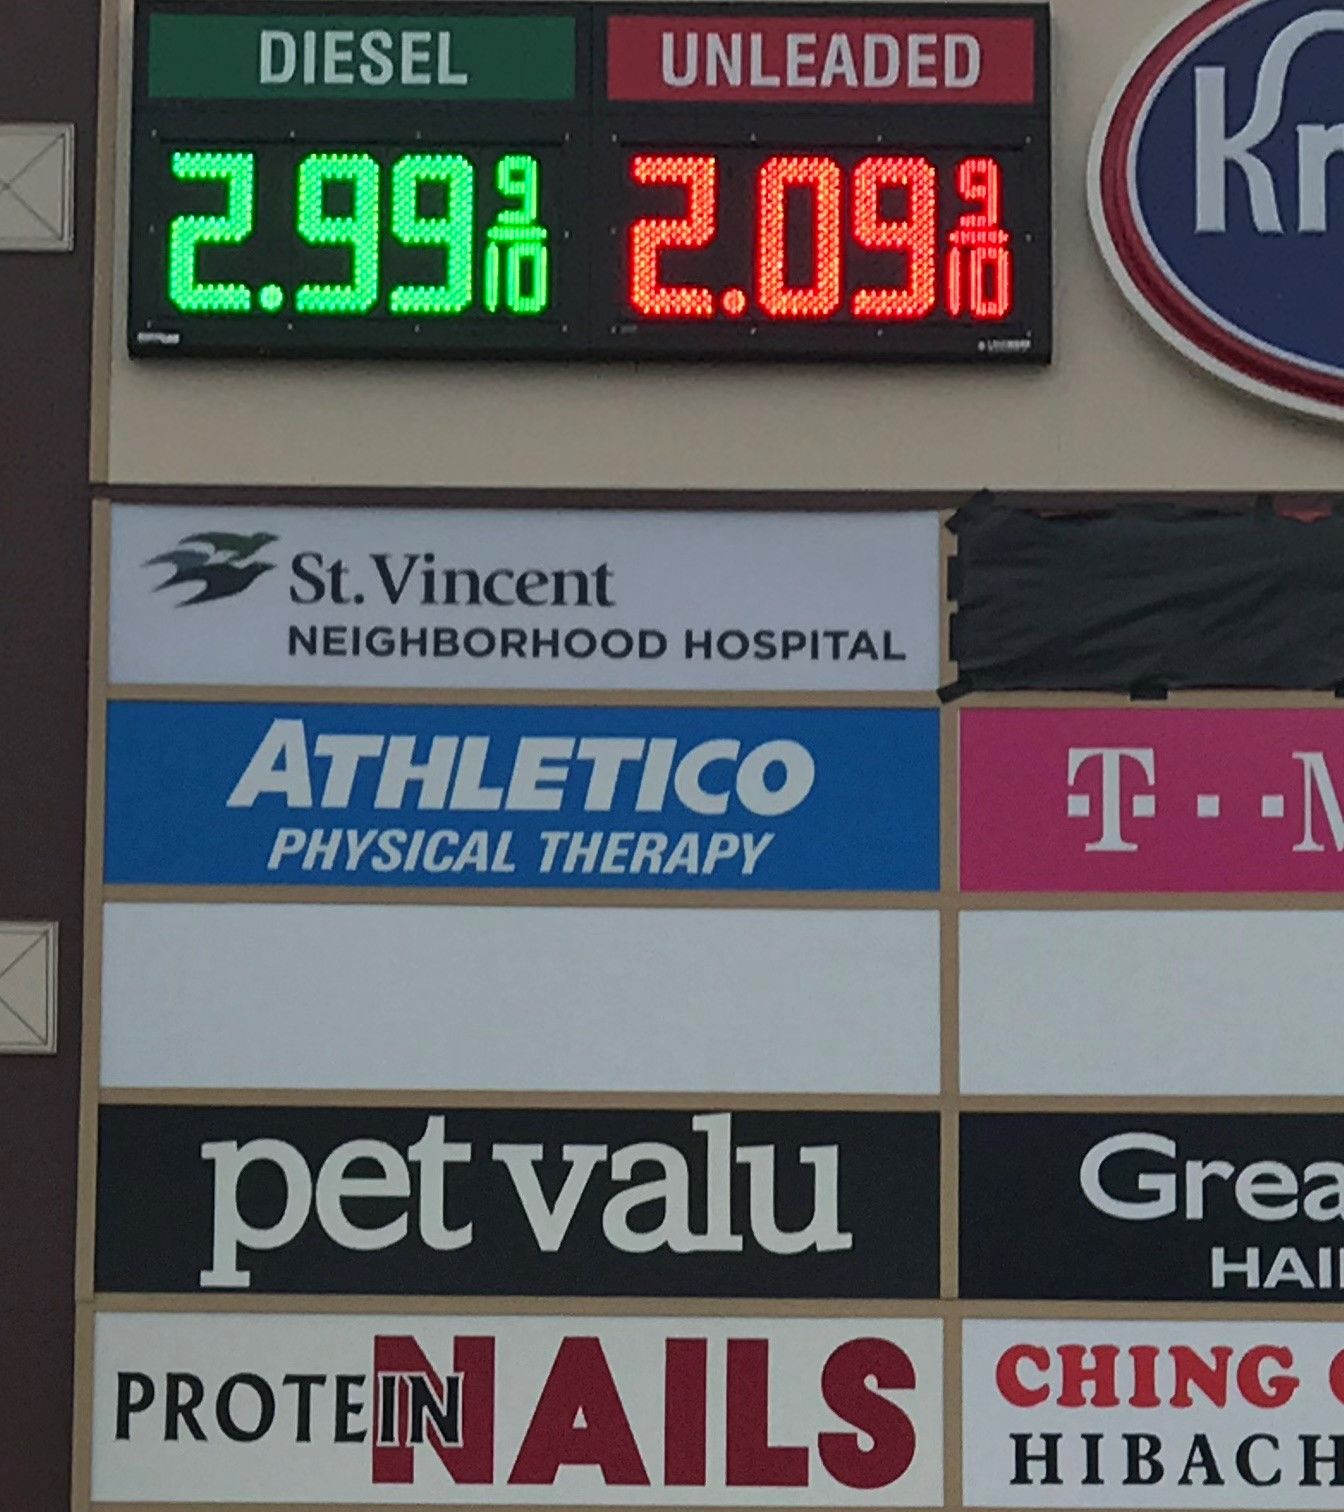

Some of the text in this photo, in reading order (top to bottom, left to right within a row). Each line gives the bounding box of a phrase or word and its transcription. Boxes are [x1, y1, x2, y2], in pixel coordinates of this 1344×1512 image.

[261, 30, 467, 85] DIESEL
[663, 33, 979, 87] UNLEADED
[170, 152, 473, 312] 2.99
[631, 157, 935, 316] 2.09
[289, 626, 906, 660] NEIGHBORHOOD HOSPITAL
[227, 719, 814, 816] ATHLETICO
[268, 828, 774, 874] PHYSICAL THERAPY
[201, 1113, 853, 1286] pet valu
[115, 1335, 916, 1489] PROTEIN NAILS
[996, 1344, 1299, 1408] CHING
